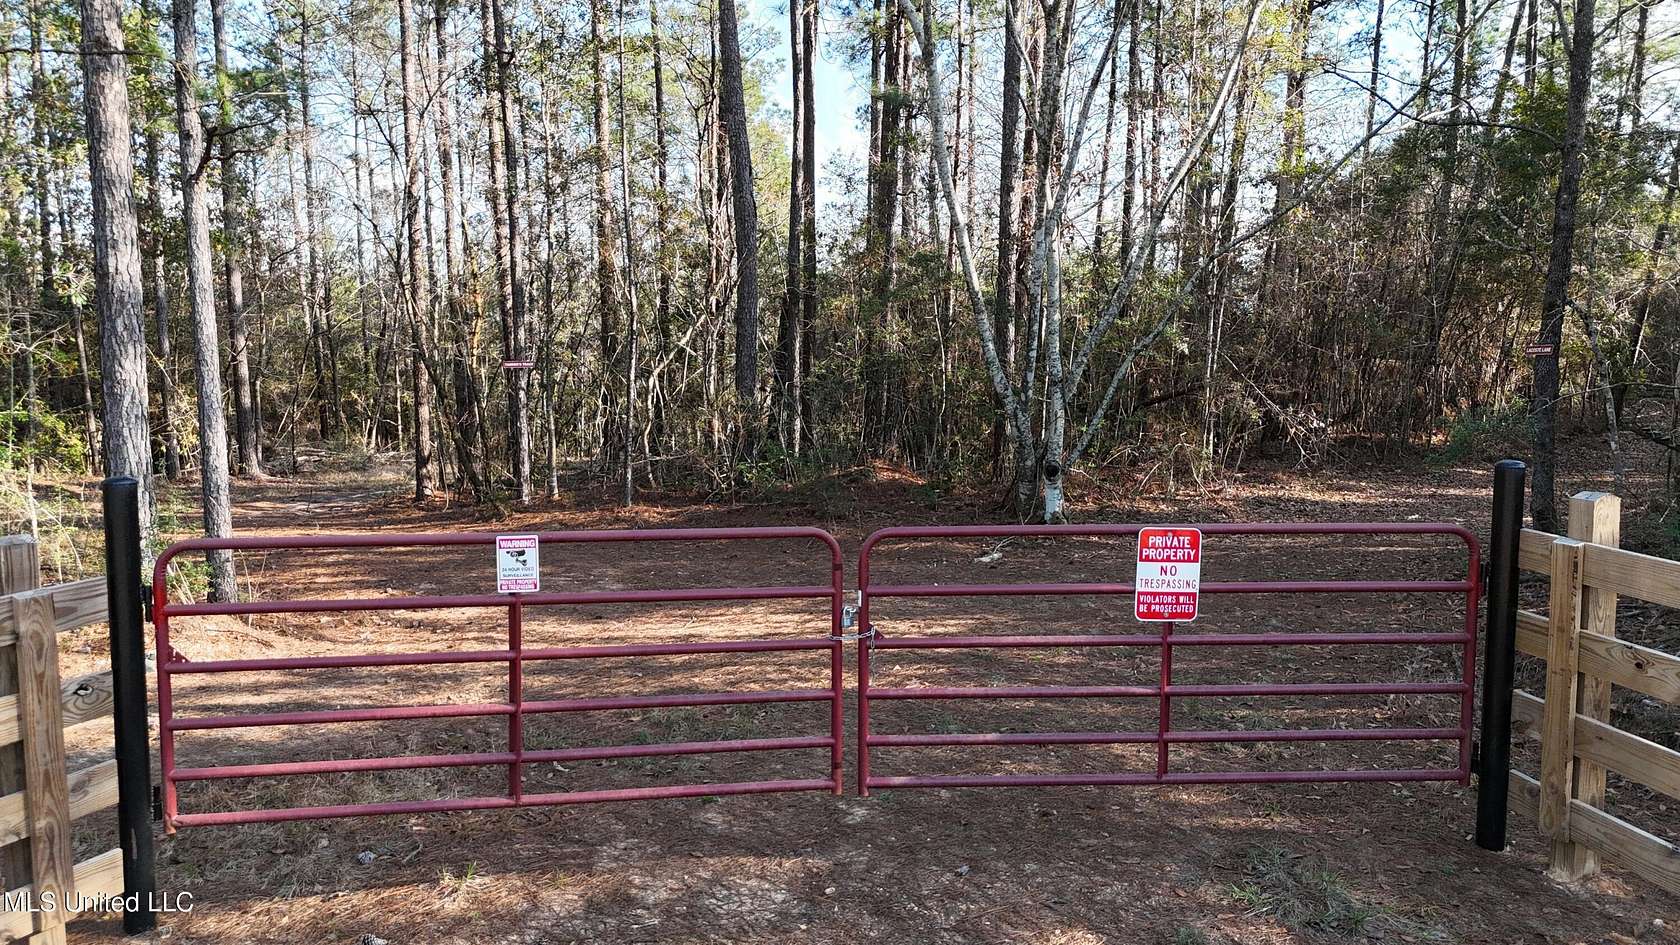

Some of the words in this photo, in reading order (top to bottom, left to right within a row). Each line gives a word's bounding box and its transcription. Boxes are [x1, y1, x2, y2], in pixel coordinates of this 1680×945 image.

[499, 539, 535, 548] WARNING
[1148, 536, 1191, 548] PRIVATE
[1142, 548, 1196, 560] PROPERTY
[1160, 565, 1178, 577] NO
[1139, 578, 1197, 590] TRESPASSING
[1139, 594, 1177, 604] VIOLATORS
[1179, 595, 1194, 604] WILL
[1139, 604, 1148, 613] BE
[1150, 604, 1194, 613] PROSECUTED
